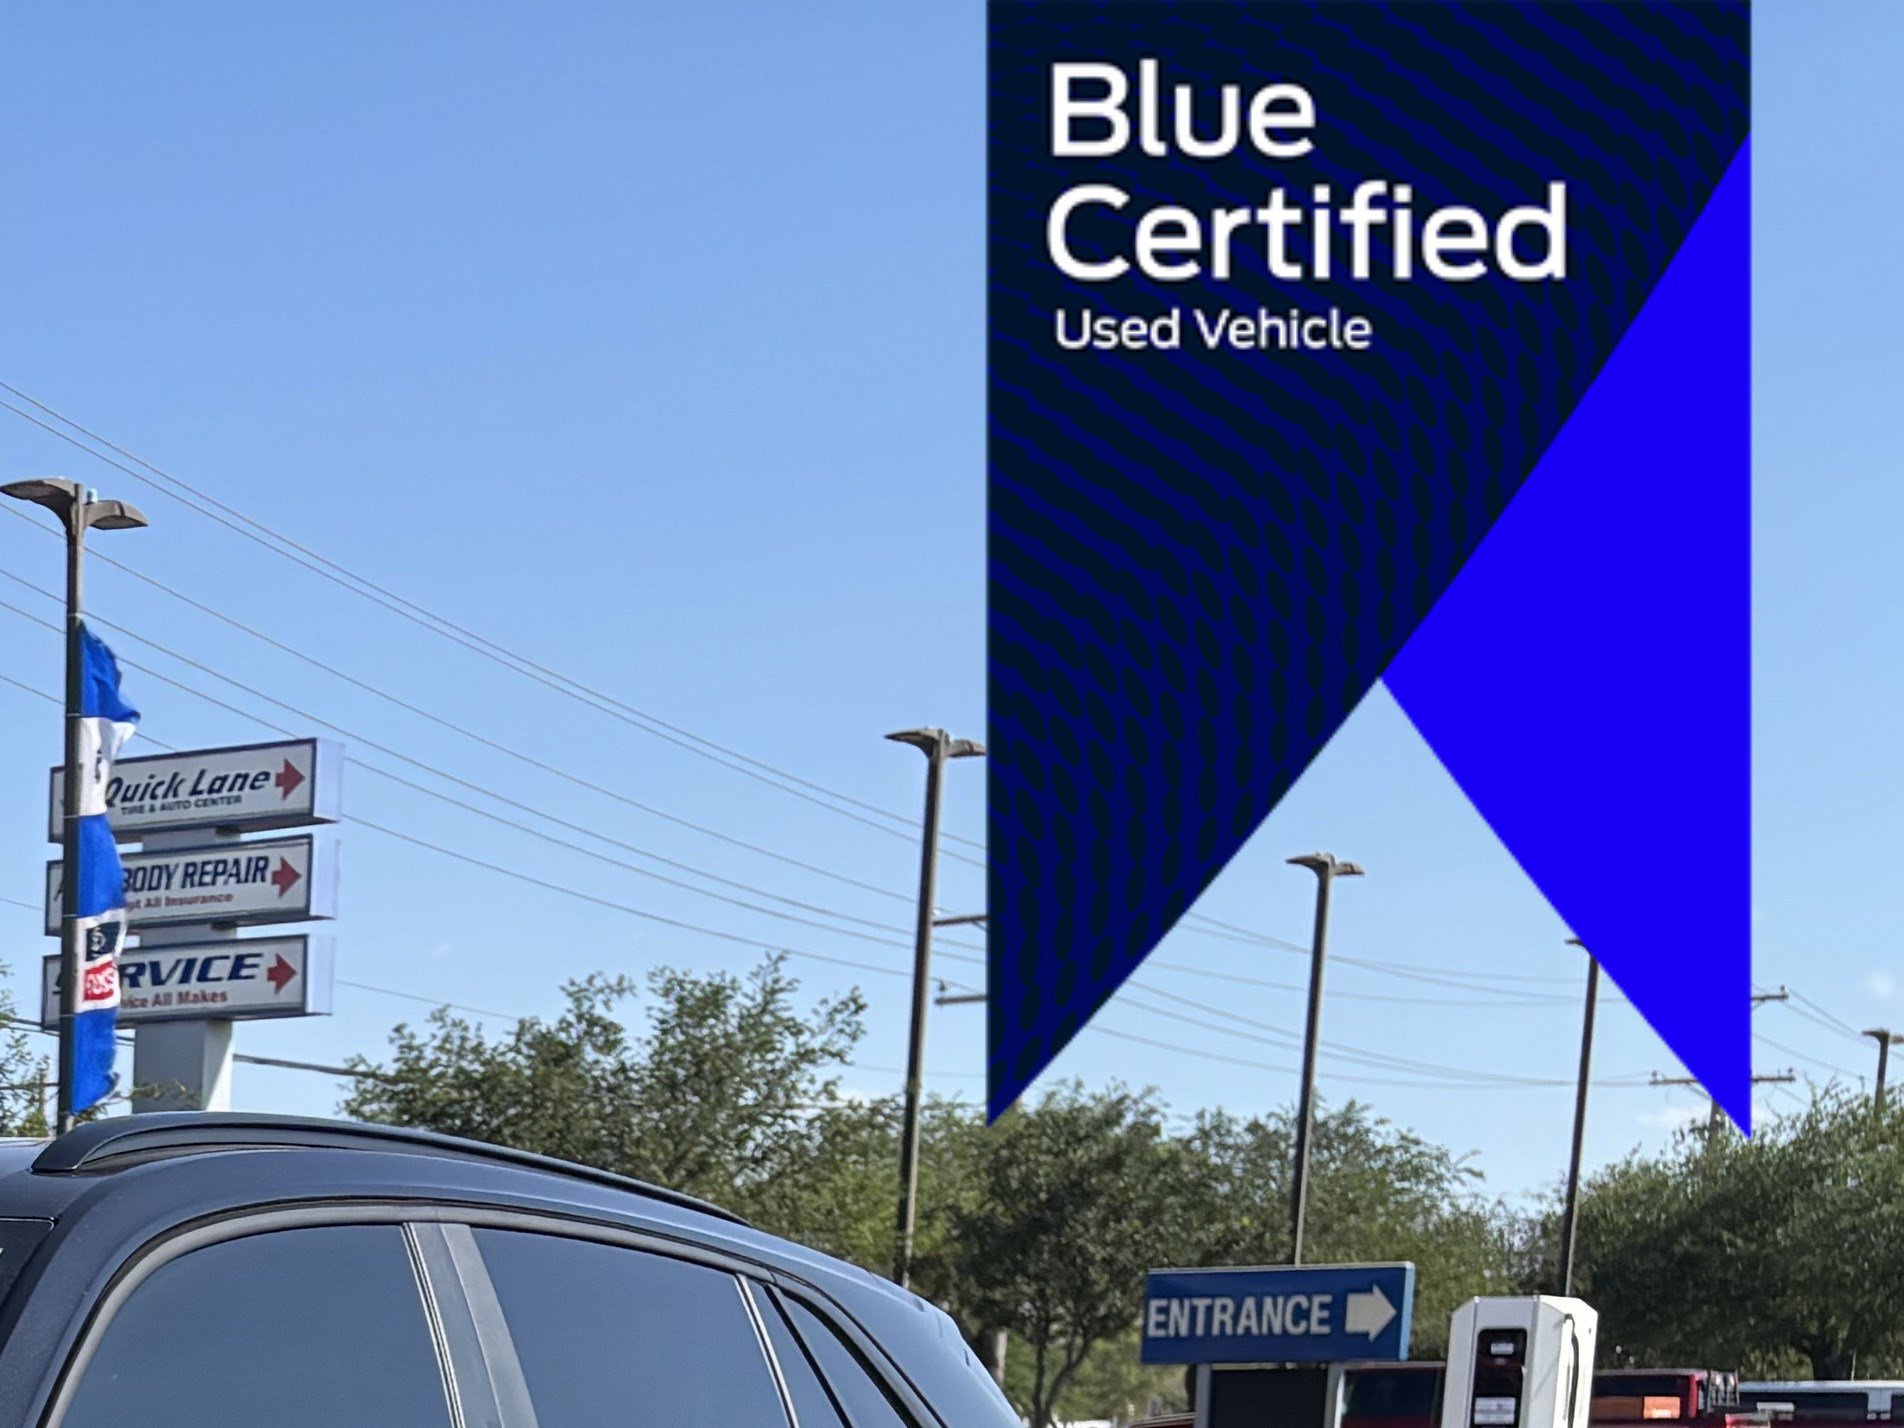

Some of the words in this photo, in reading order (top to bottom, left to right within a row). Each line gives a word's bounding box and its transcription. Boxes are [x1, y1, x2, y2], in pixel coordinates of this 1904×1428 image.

[104, 771, 186, 808] Quick
[189, 768, 271, 797] Lane
[121, 804, 145, 816] TIRE
[147, 803, 156, 813] &
[159, 799, 191, 812] AUTO
[193, 794, 243, 809] CENTER
[122, 860, 180, 893] BODY
[181, 855, 270, 889] REPAIR
[144, 894, 162, 908] All
[164, 892, 234, 907] Insurance
[119, 952, 265, 988] RVICE
[151, 992, 173, 1006] All
[177, 988, 229, 1005] Makes
[1147, 1293, 1334, 1338] ENTRANCE
